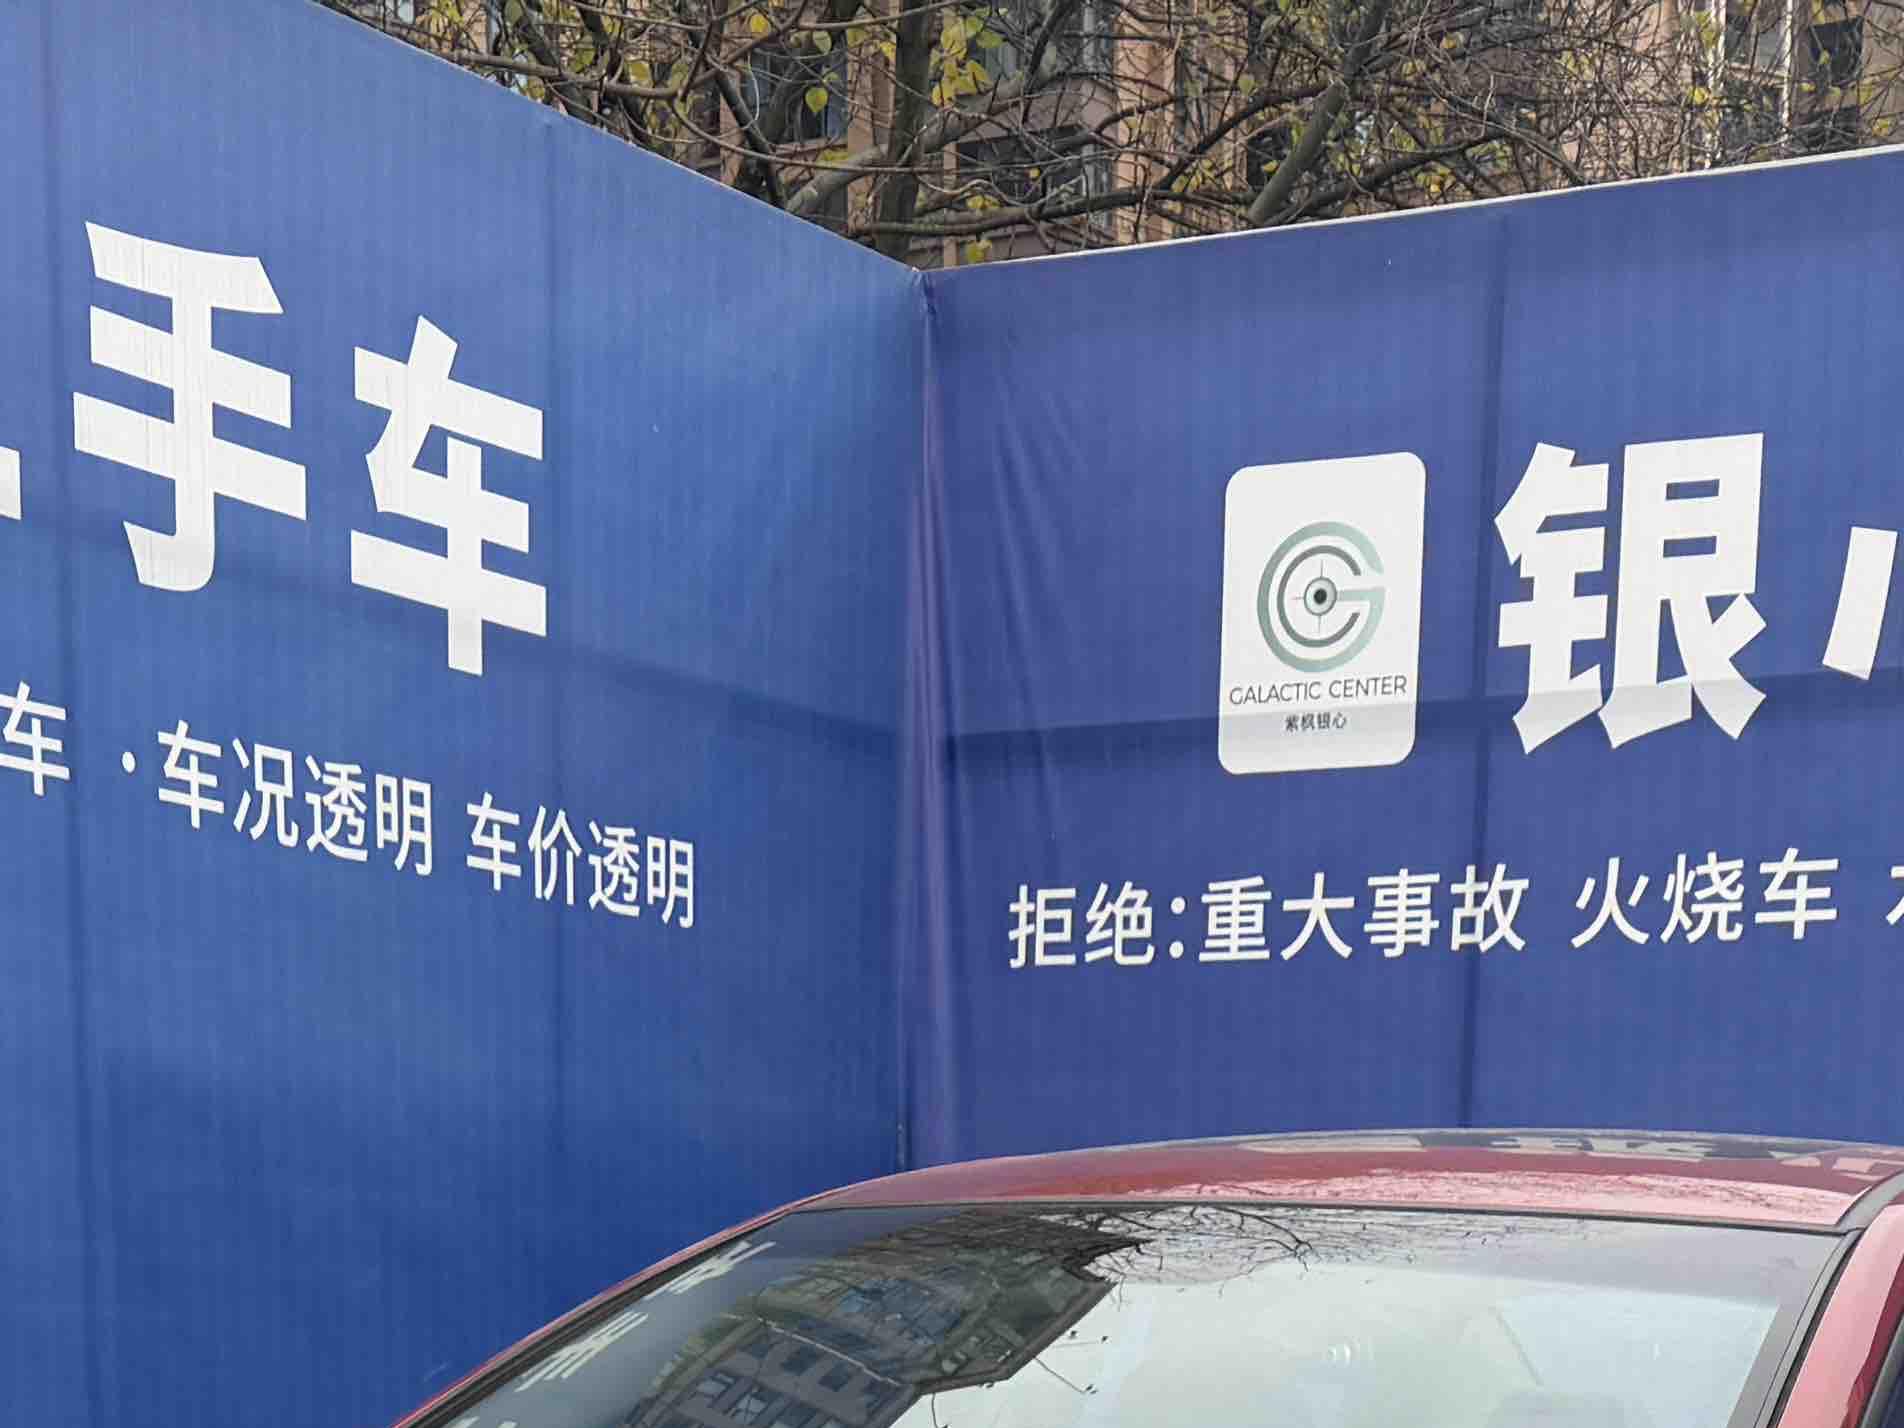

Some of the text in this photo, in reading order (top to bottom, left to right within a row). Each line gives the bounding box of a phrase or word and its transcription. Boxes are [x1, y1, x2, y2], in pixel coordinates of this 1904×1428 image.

[1229, 675, 1408, 705] GALACTIC CENTER
[466, 792, 695, 929] 车价透明
[1571, 847, 1840, 949] 火烧车
